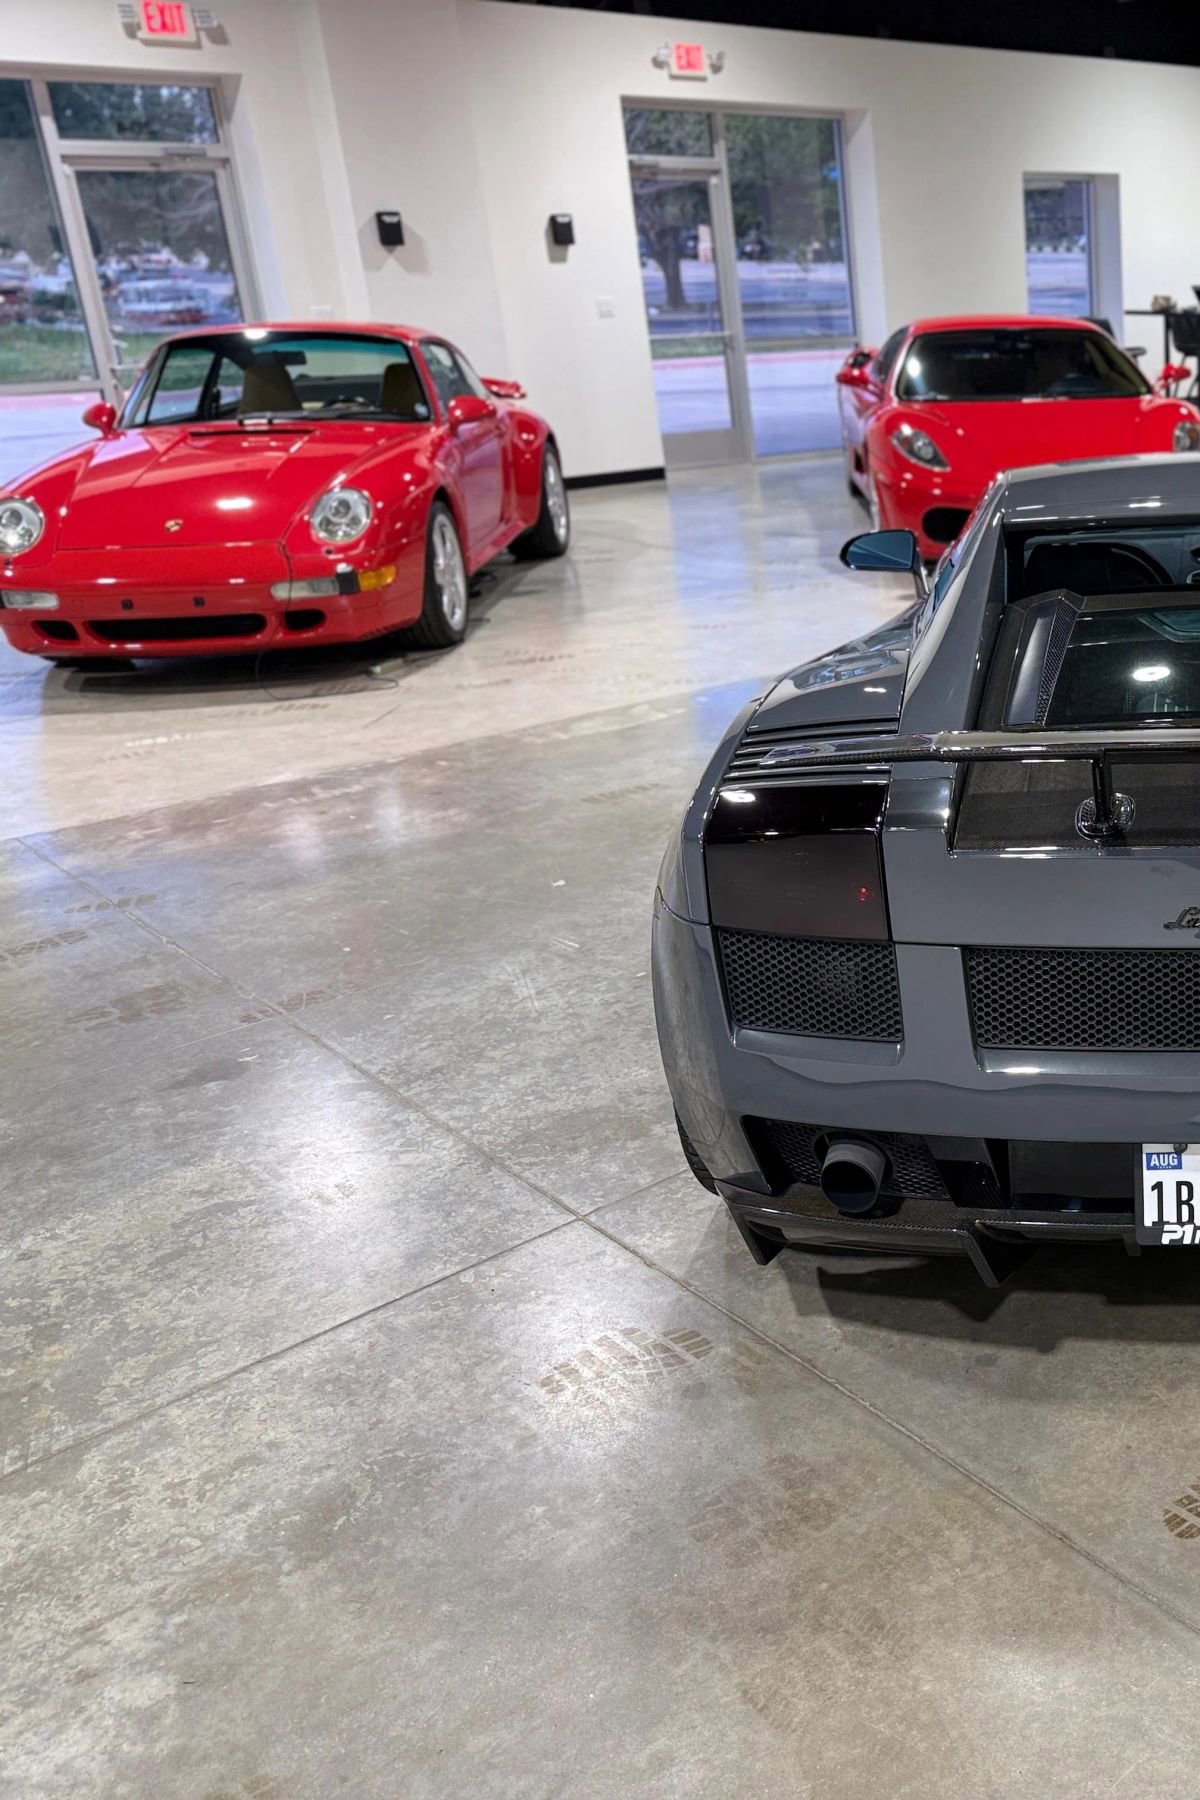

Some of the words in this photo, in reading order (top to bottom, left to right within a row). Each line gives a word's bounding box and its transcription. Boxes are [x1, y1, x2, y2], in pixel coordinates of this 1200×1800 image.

[142, 0, 186, 34] EXIT
[675, 43, 704, 72] EXIT
[1149, 1153, 1179, 1167] AUG
[1160, 1223, 1195, 1245] P1
